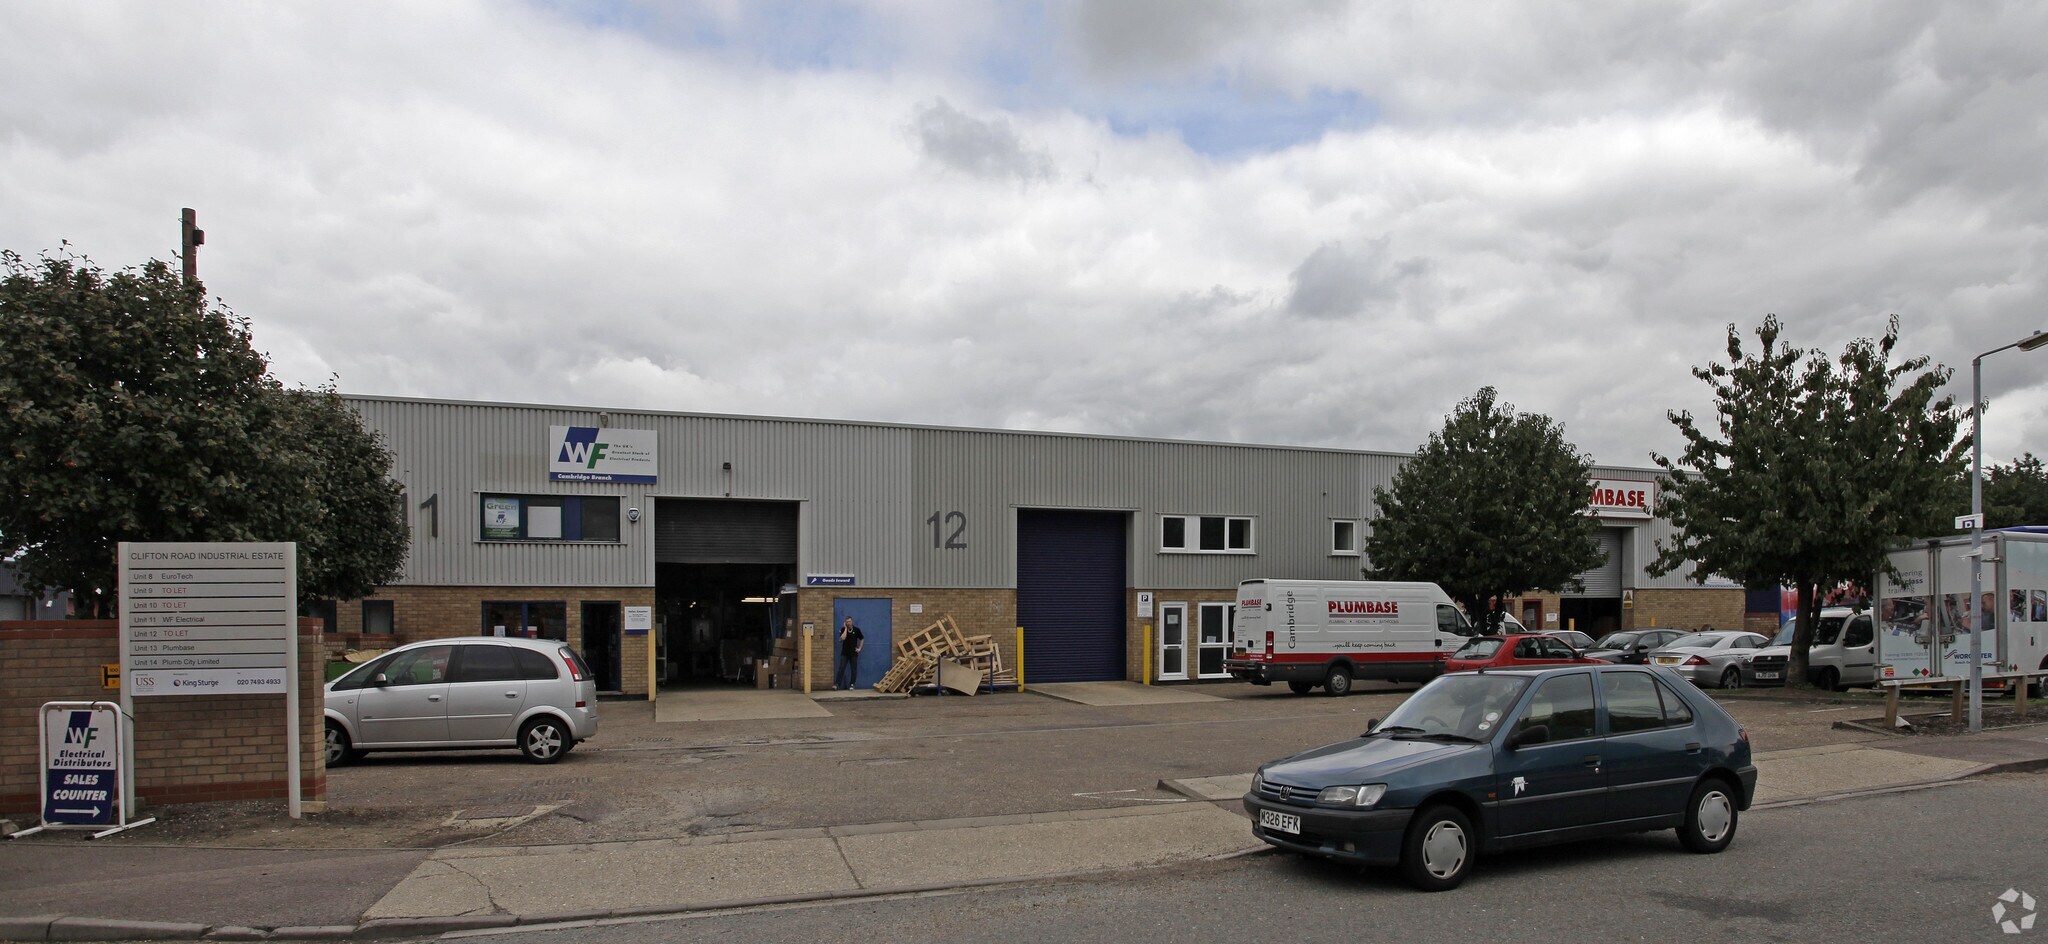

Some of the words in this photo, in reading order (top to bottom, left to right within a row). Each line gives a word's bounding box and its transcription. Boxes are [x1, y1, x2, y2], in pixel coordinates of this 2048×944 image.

[558, 442, 609, 468] WF
[1588, 489, 1644, 507] MBASE
[927, 511, 967, 549] 12
[1328, 601, 1398, 613] PLUMBASE
[1286, 591, 1295, 649] Cambridge
[136, 678, 154, 686] USS
[65, 727, 98, 748] WF
[60, 750, 105, 758] Electrical
[53, 759, 111, 767] Distributors
[64, 774, 99, 785] SALES
[53, 790, 107, 801] COUNTER
[1261, 810, 1280, 826] M326
[1282, 815, 1299, 831] EFK
